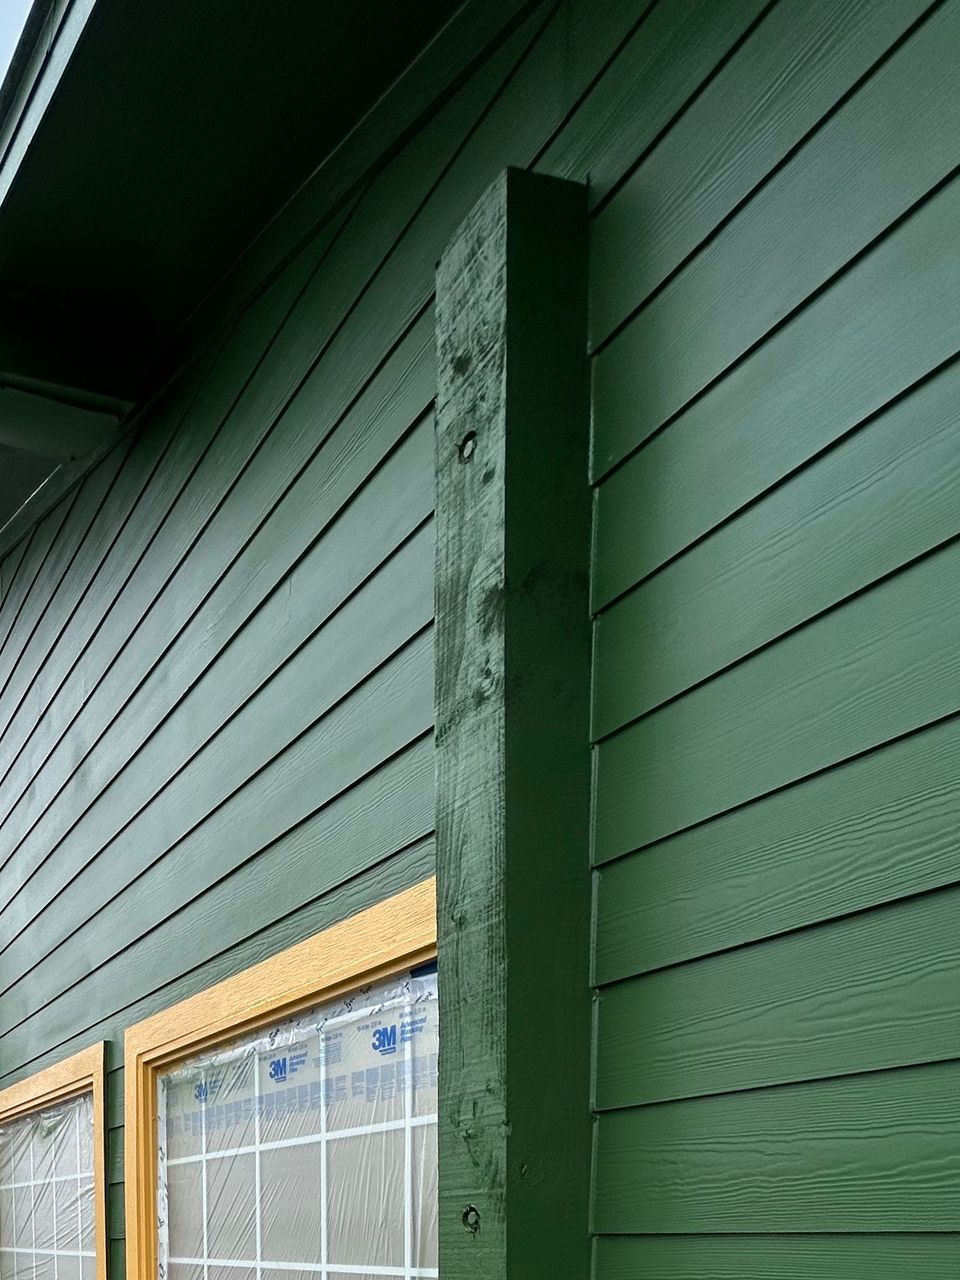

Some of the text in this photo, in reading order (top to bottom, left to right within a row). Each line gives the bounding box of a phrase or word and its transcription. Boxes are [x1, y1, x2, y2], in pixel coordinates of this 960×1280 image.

[372, 1025, 397, 1051] 3M
[269, 1057, 287, 1079] 3M
[194, 1083, 208, 1099] 3M
